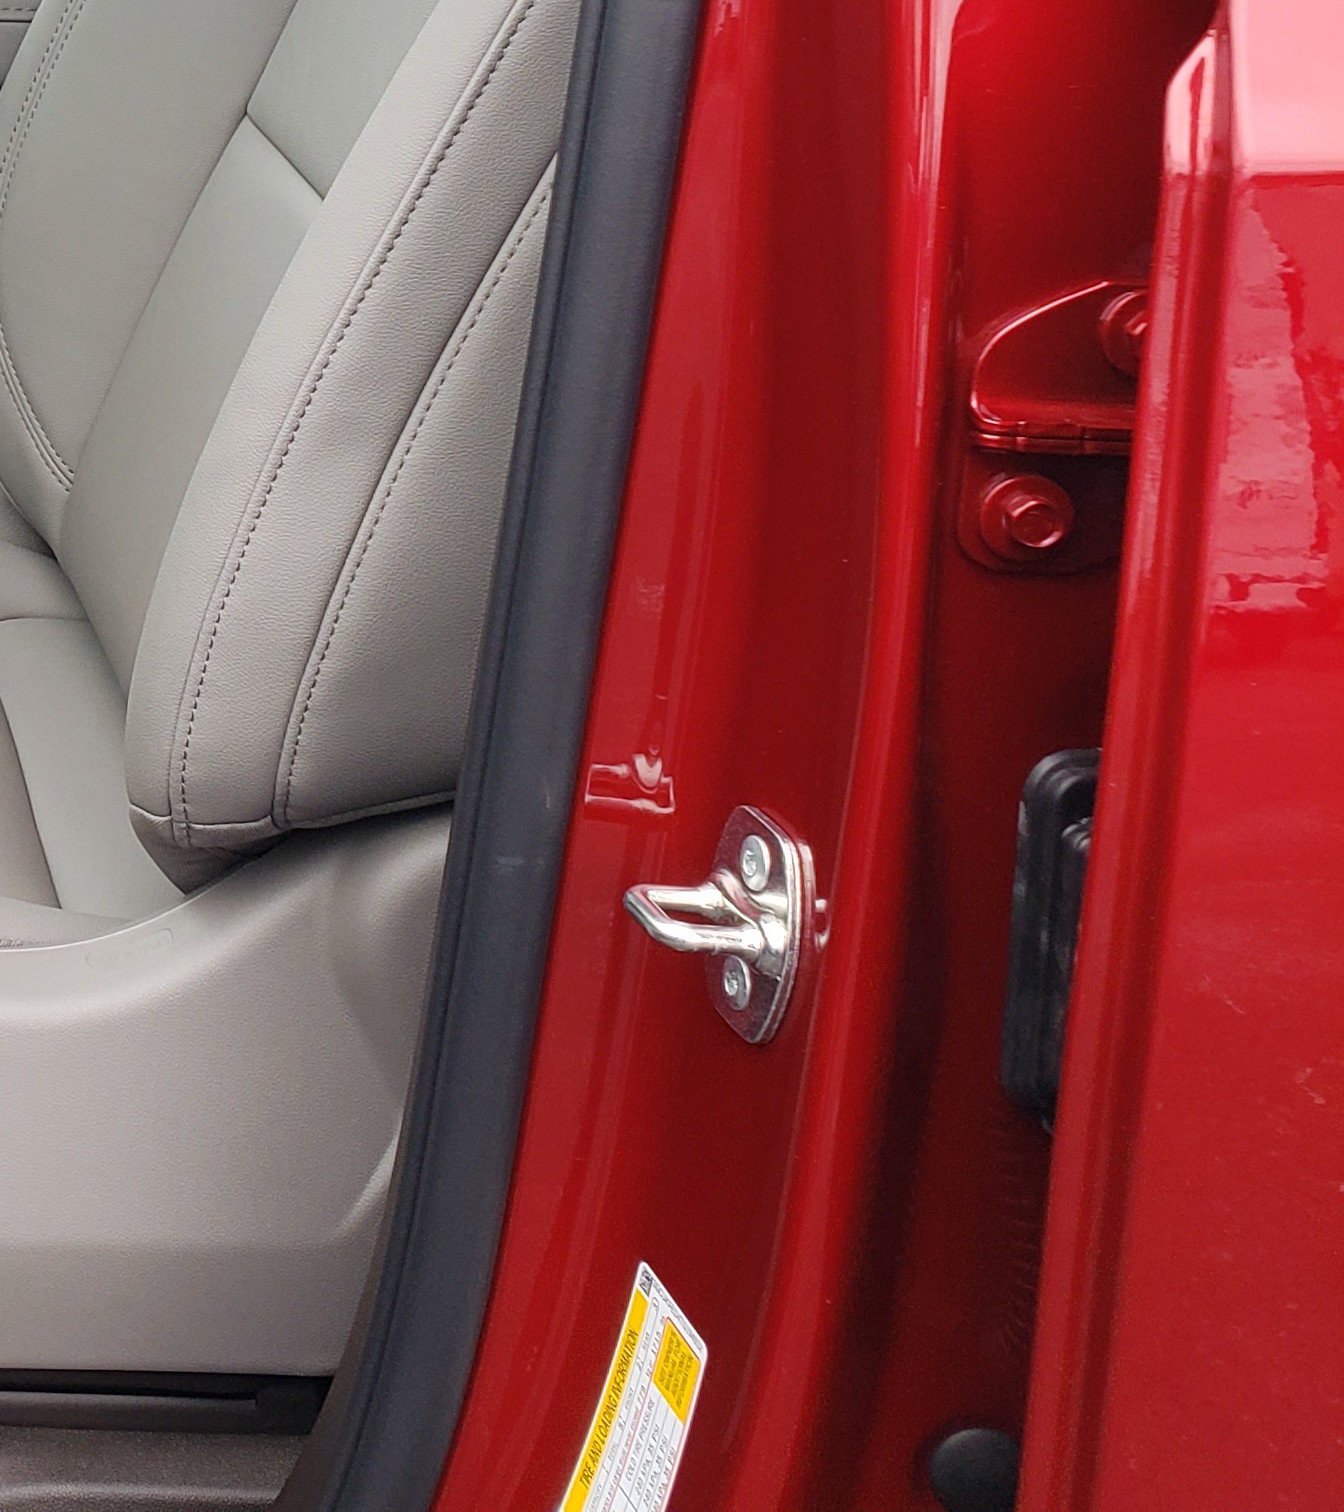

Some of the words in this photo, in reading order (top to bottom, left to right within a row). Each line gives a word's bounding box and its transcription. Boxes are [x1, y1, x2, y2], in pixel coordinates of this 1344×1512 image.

[579, 1462, 594, 1490] TIRE
[587, 1439, 602, 1467] AND
[595, 1394, 617, 1444] LOADING
[611, 1328, 637, 1399] INFORMATION
